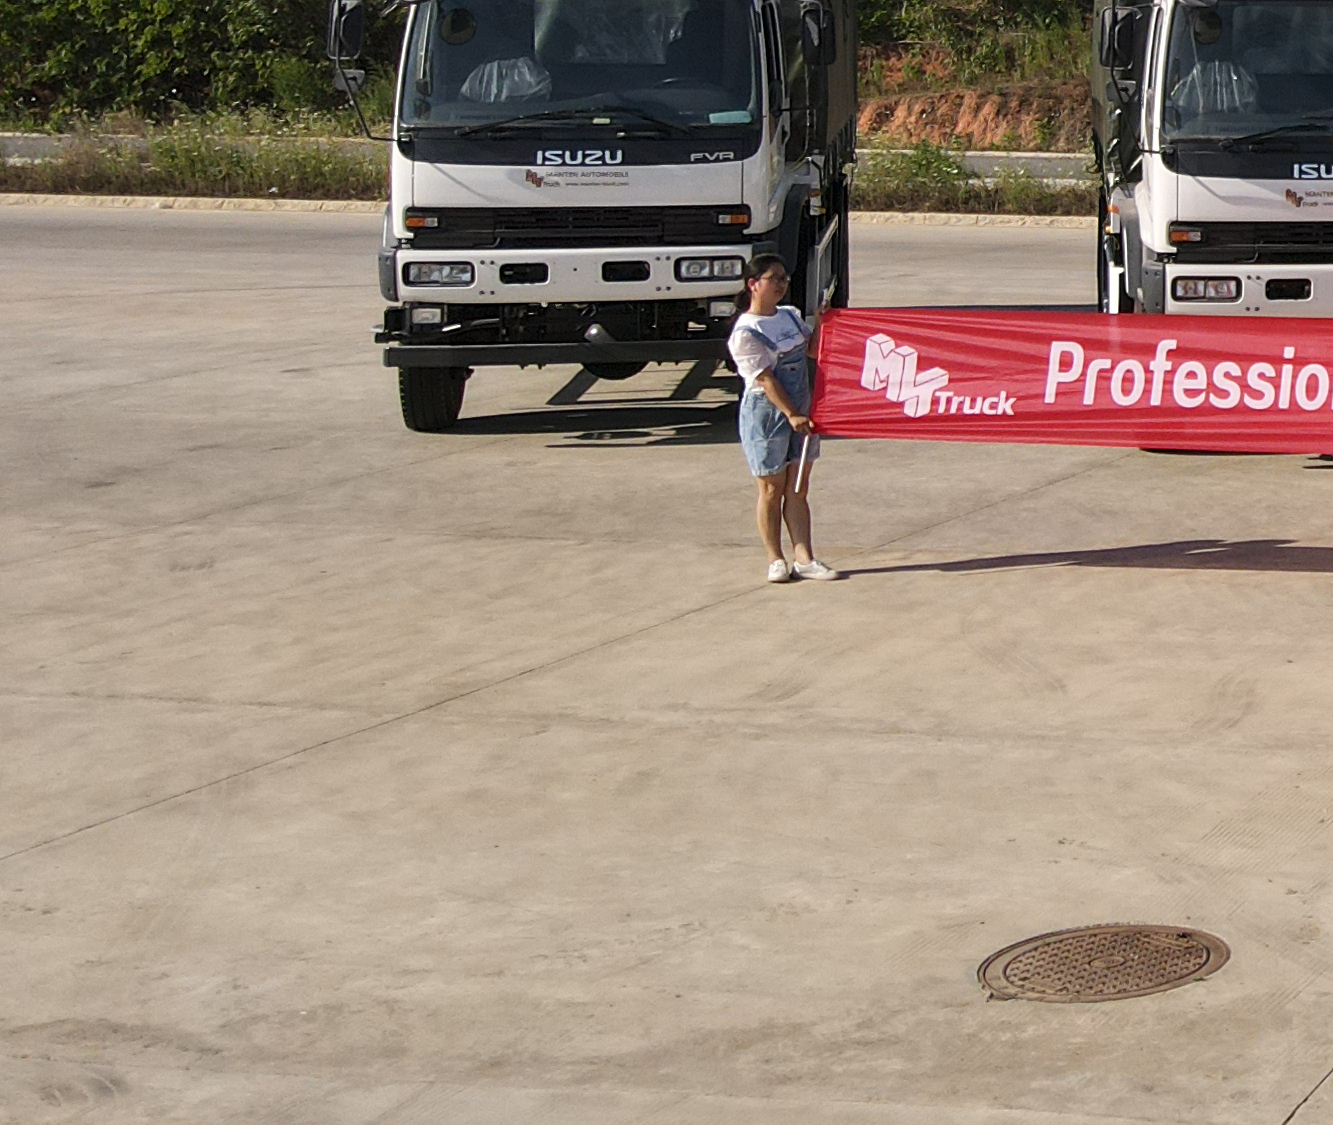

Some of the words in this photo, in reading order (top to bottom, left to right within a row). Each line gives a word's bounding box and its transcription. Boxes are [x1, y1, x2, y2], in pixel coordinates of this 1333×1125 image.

[536, 149, 623, 165] ISUZU
[690, 151, 735, 162] FVR
[935, 390, 1017, 416] Truck
